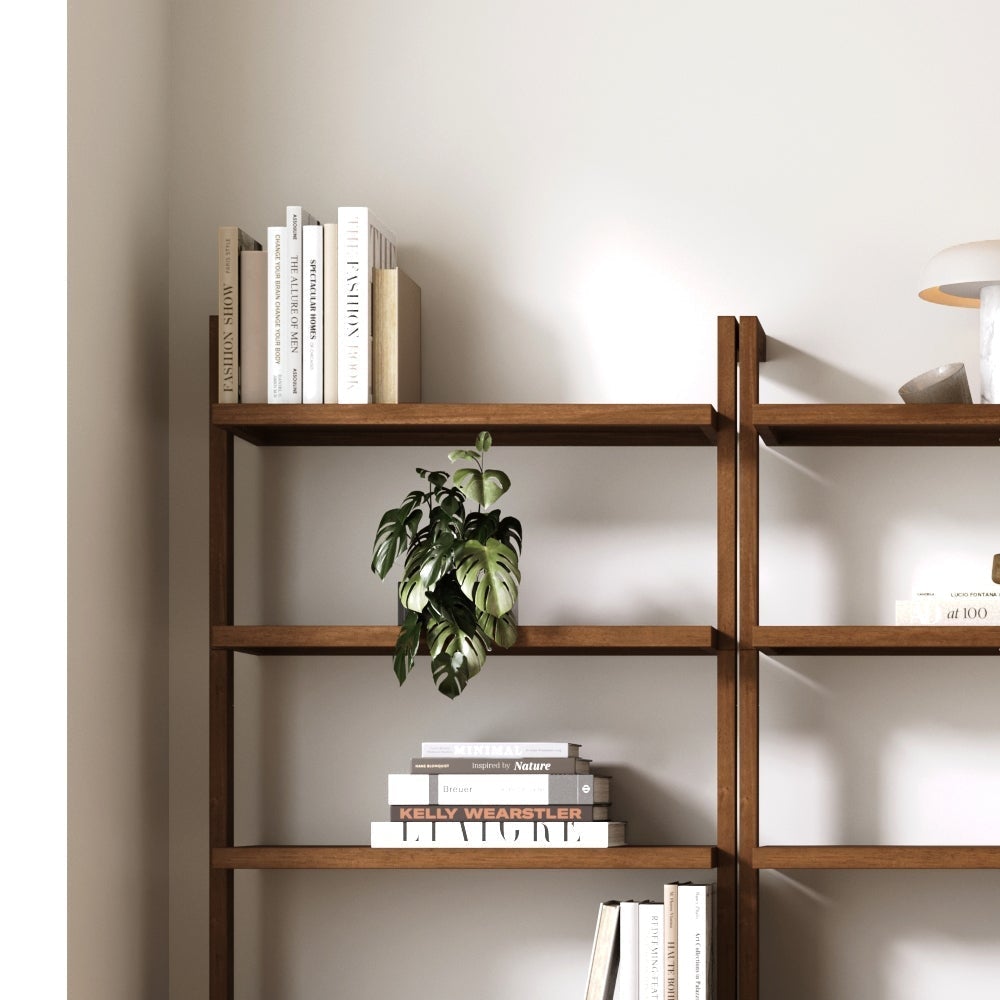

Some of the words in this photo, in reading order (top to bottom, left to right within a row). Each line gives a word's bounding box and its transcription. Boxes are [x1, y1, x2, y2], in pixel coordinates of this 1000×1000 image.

[291, 255, 299, 274] THE
[223, 284, 234, 327] SHOW
[291, 276, 299, 314] ALLURE
[347, 261, 359, 338] FASHION
[291, 316, 299, 329] OF
[291, 331, 299, 353] MEN
[223, 331, 234, 392] FASHION
[947, 607, 959, 619] at
[962, 607, 988, 620] 100
[454, 745, 523, 756] MINIMAL
[471, 761, 500, 771] Inspired
[501, 761, 511, 771] by
[513, 761, 551, 771] Nature
[400, 807, 458, 820] KELLY
[463, 807, 582, 820] WEARSTLER
[651, 915, 659, 973] REDEEMING
[668, 941, 676, 974] HAUTE
